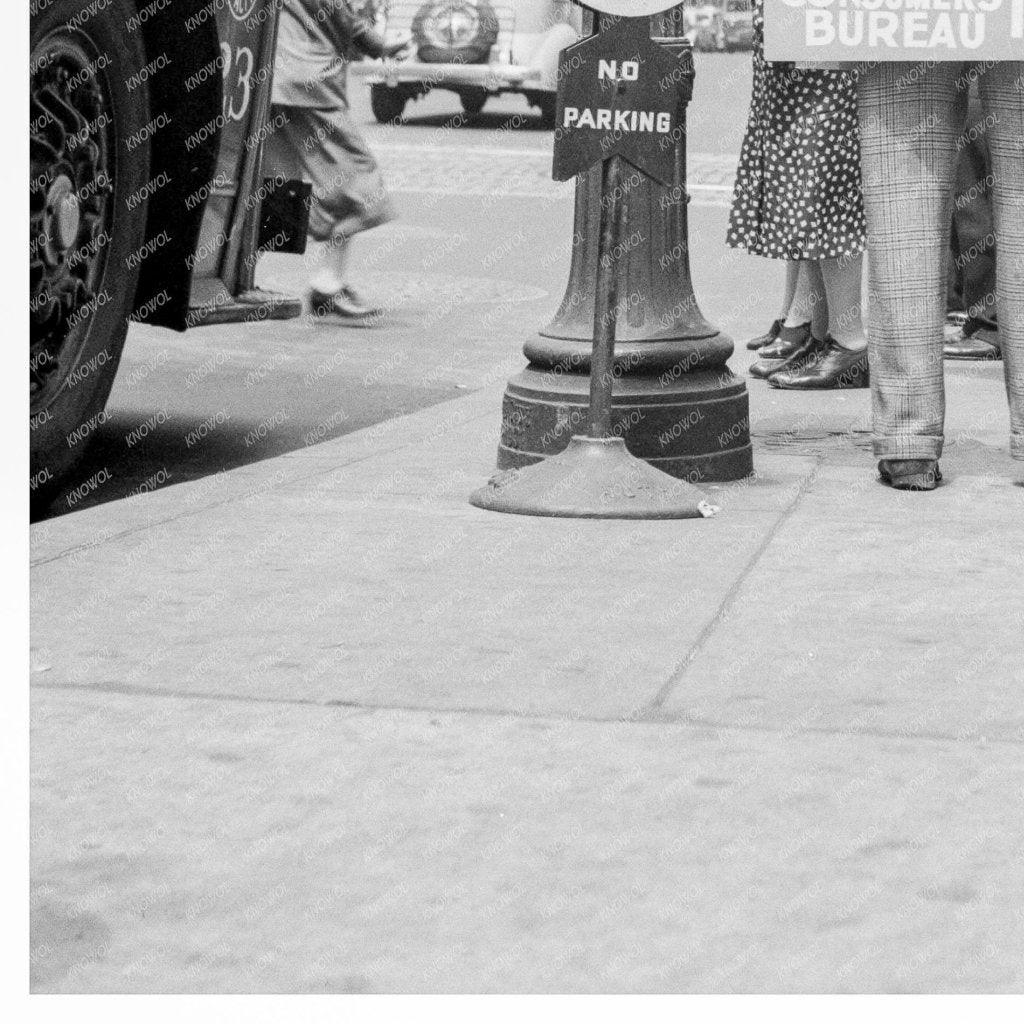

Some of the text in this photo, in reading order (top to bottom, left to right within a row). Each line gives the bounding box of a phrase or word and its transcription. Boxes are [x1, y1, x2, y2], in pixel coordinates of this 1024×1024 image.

[805, 9, 985, 50] BUREAU
[597, 60, 640, 82] NO
[563, 107, 671, 133] PARKING
